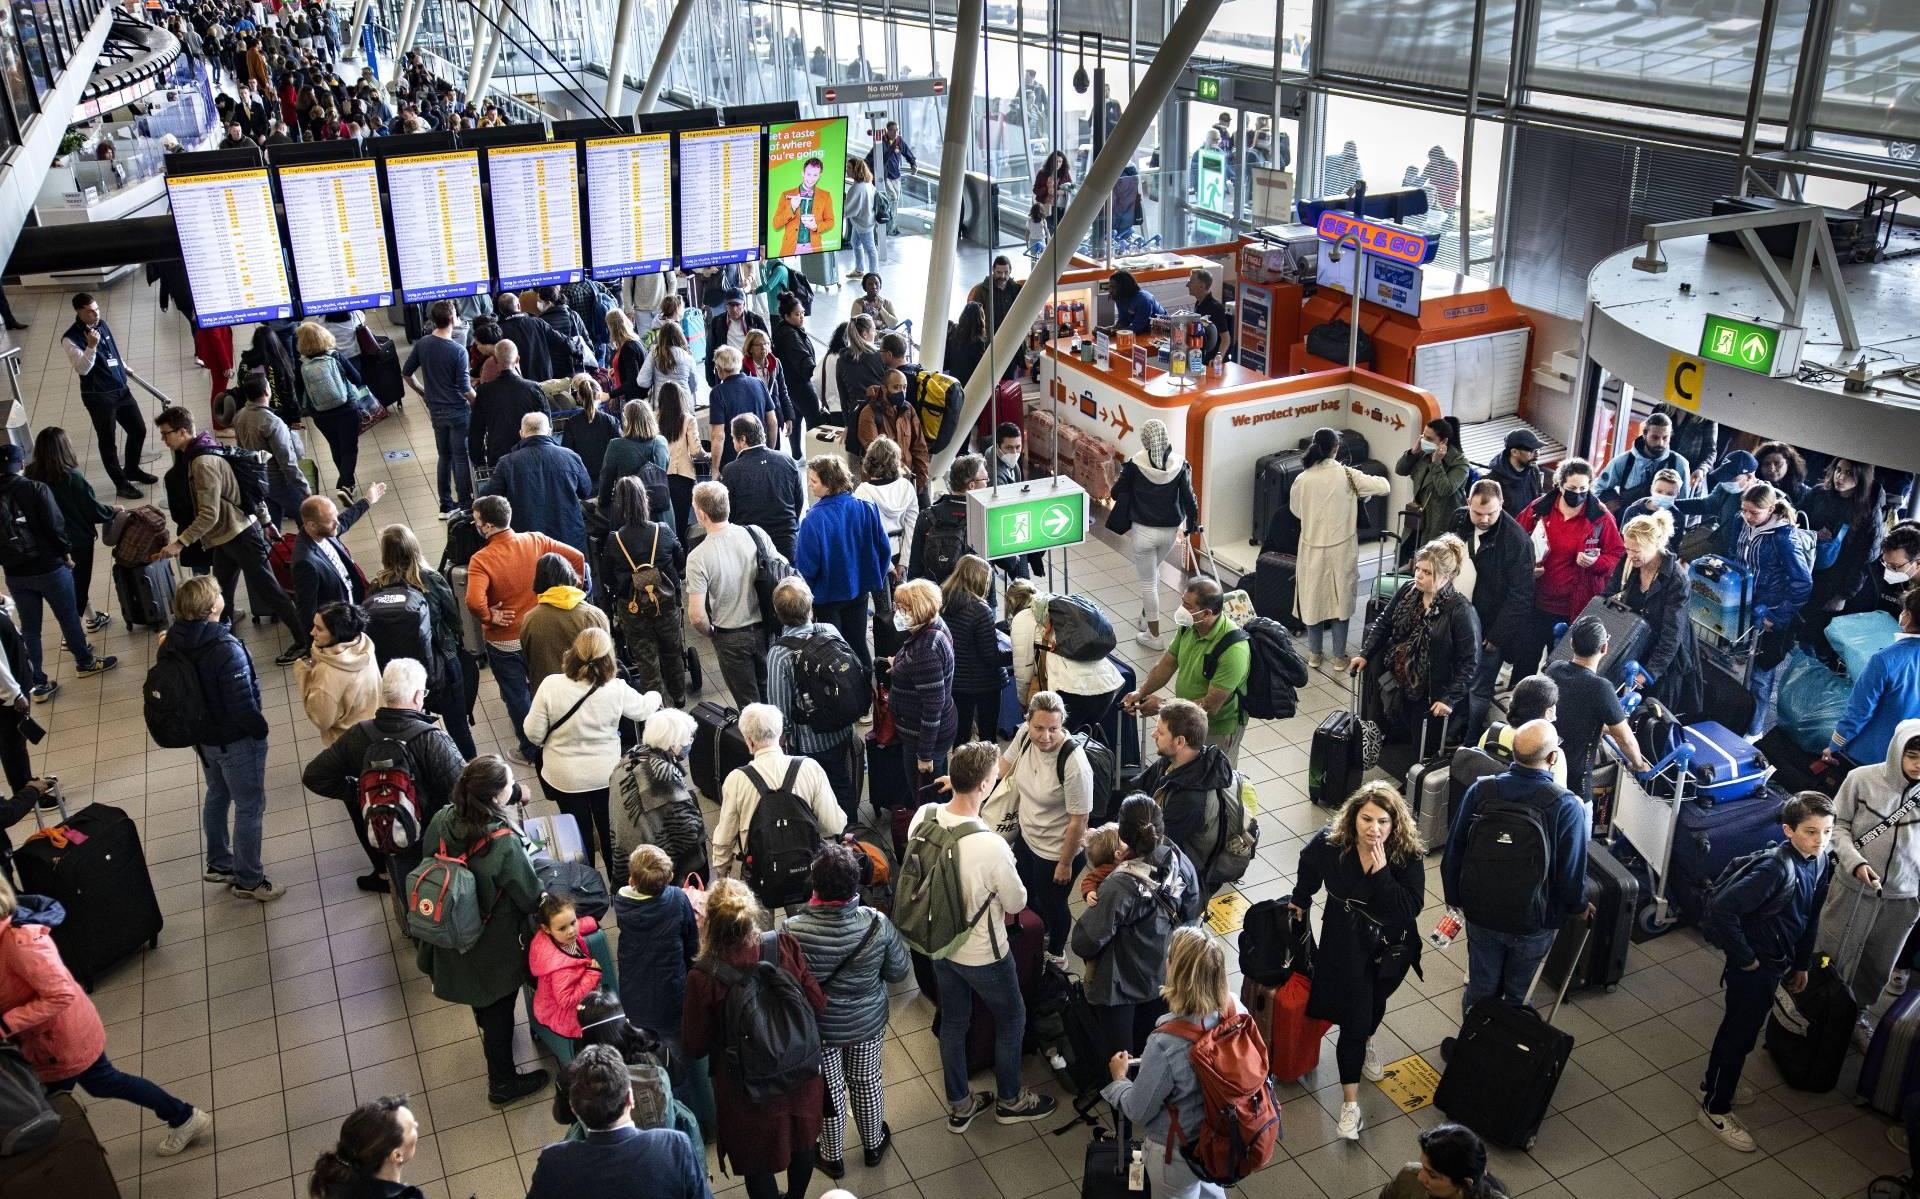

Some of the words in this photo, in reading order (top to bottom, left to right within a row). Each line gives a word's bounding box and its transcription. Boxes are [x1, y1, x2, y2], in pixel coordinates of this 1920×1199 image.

[880, 84, 899, 92] entry
[769, 141, 781, 150] of
[782, 140, 812, 149] where
[792, 130, 815, 138] taste
[769, 151, 795, 160] ou're
[797, 149, 824, 160] going
[1322, 217, 1370, 244] SEAL
[1373, 232, 1387, 248] &
[1390, 237, 1420, 256] GO
[1675, 362, 1696, 400] C
[1232, 413, 1251, 427] We
[1253, 407, 1293, 425] protect
[1295, 402, 1320, 418] your
[1320, 399, 1340, 411] bag
[1887, 800, 1917, 826] SEASIDE
[1860, 823, 1888, 846] SEASIDE
